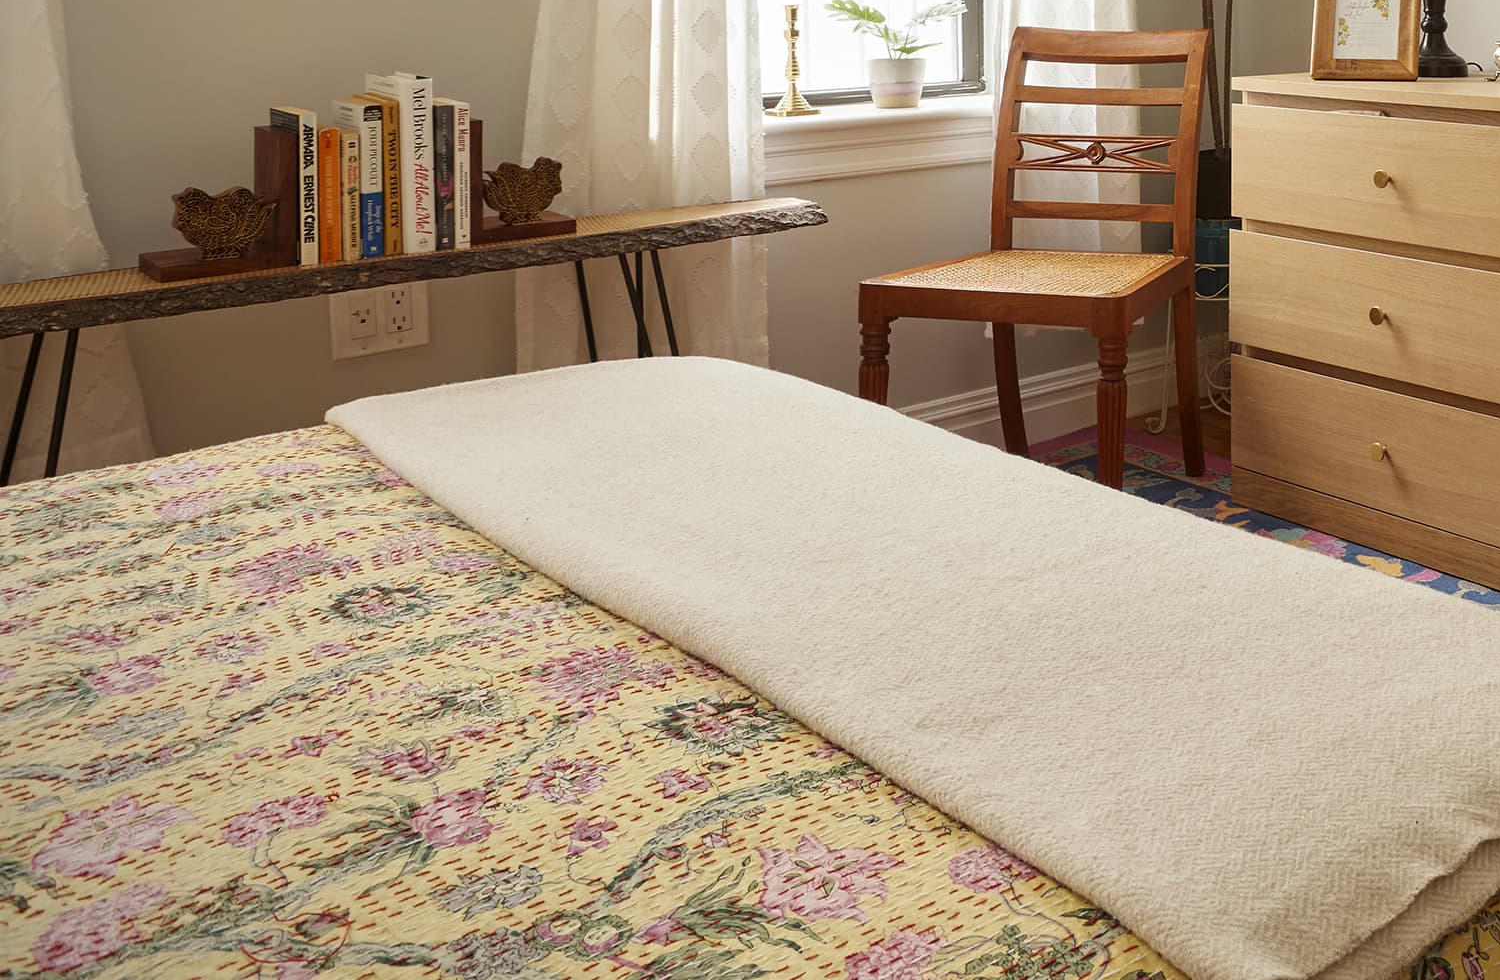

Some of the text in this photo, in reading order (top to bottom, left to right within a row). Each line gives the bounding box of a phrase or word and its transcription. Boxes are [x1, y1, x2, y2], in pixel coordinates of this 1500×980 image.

[412, 88, 428, 160] Mel Brooks
[458, 108, 468, 126] Alice
[303, 124, 314, 169] ARMADA
[388, 130, 397, 156] TWO
[458, 129, 468, 152] Munro
[368, 126, 378, 187] JODI PICOULT
[389, 158, 397, 171] IN
[390, 174, 398, 200] THE
[414, 163, 432, 234] All About Me!
[304, 176, 315, 243] ERNEST CLINE
[391, 202, 399, 228] CITY
